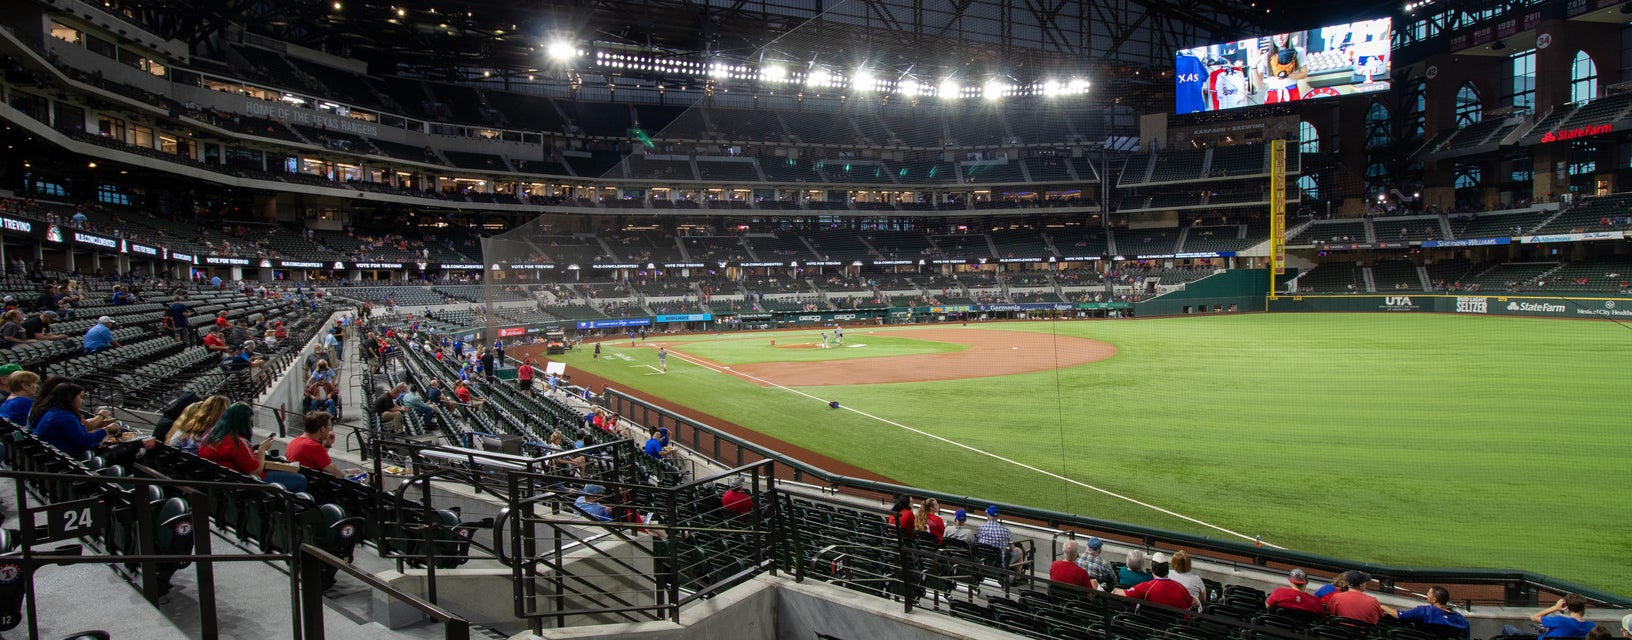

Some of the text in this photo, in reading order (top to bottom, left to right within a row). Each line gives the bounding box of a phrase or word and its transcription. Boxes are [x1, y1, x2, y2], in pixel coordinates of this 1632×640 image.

[1524, 11, 1541, 22] 2011
[1499, 19, 1516, 30] 1999
[1538, 35, 1549, 46] 34
[1427, 66, 1437, 77] 42
[246, 102, 378, 136] HOME OF THE TEXAS RANGERS
[4, 218, 31, 233] TREVINO
[1385, 296, 1412, 306] UTA
[1456, 301, 1488, 314] SELTZER
[63, 507, 93, 532] 24
[2, 615, 12, 625] 12
